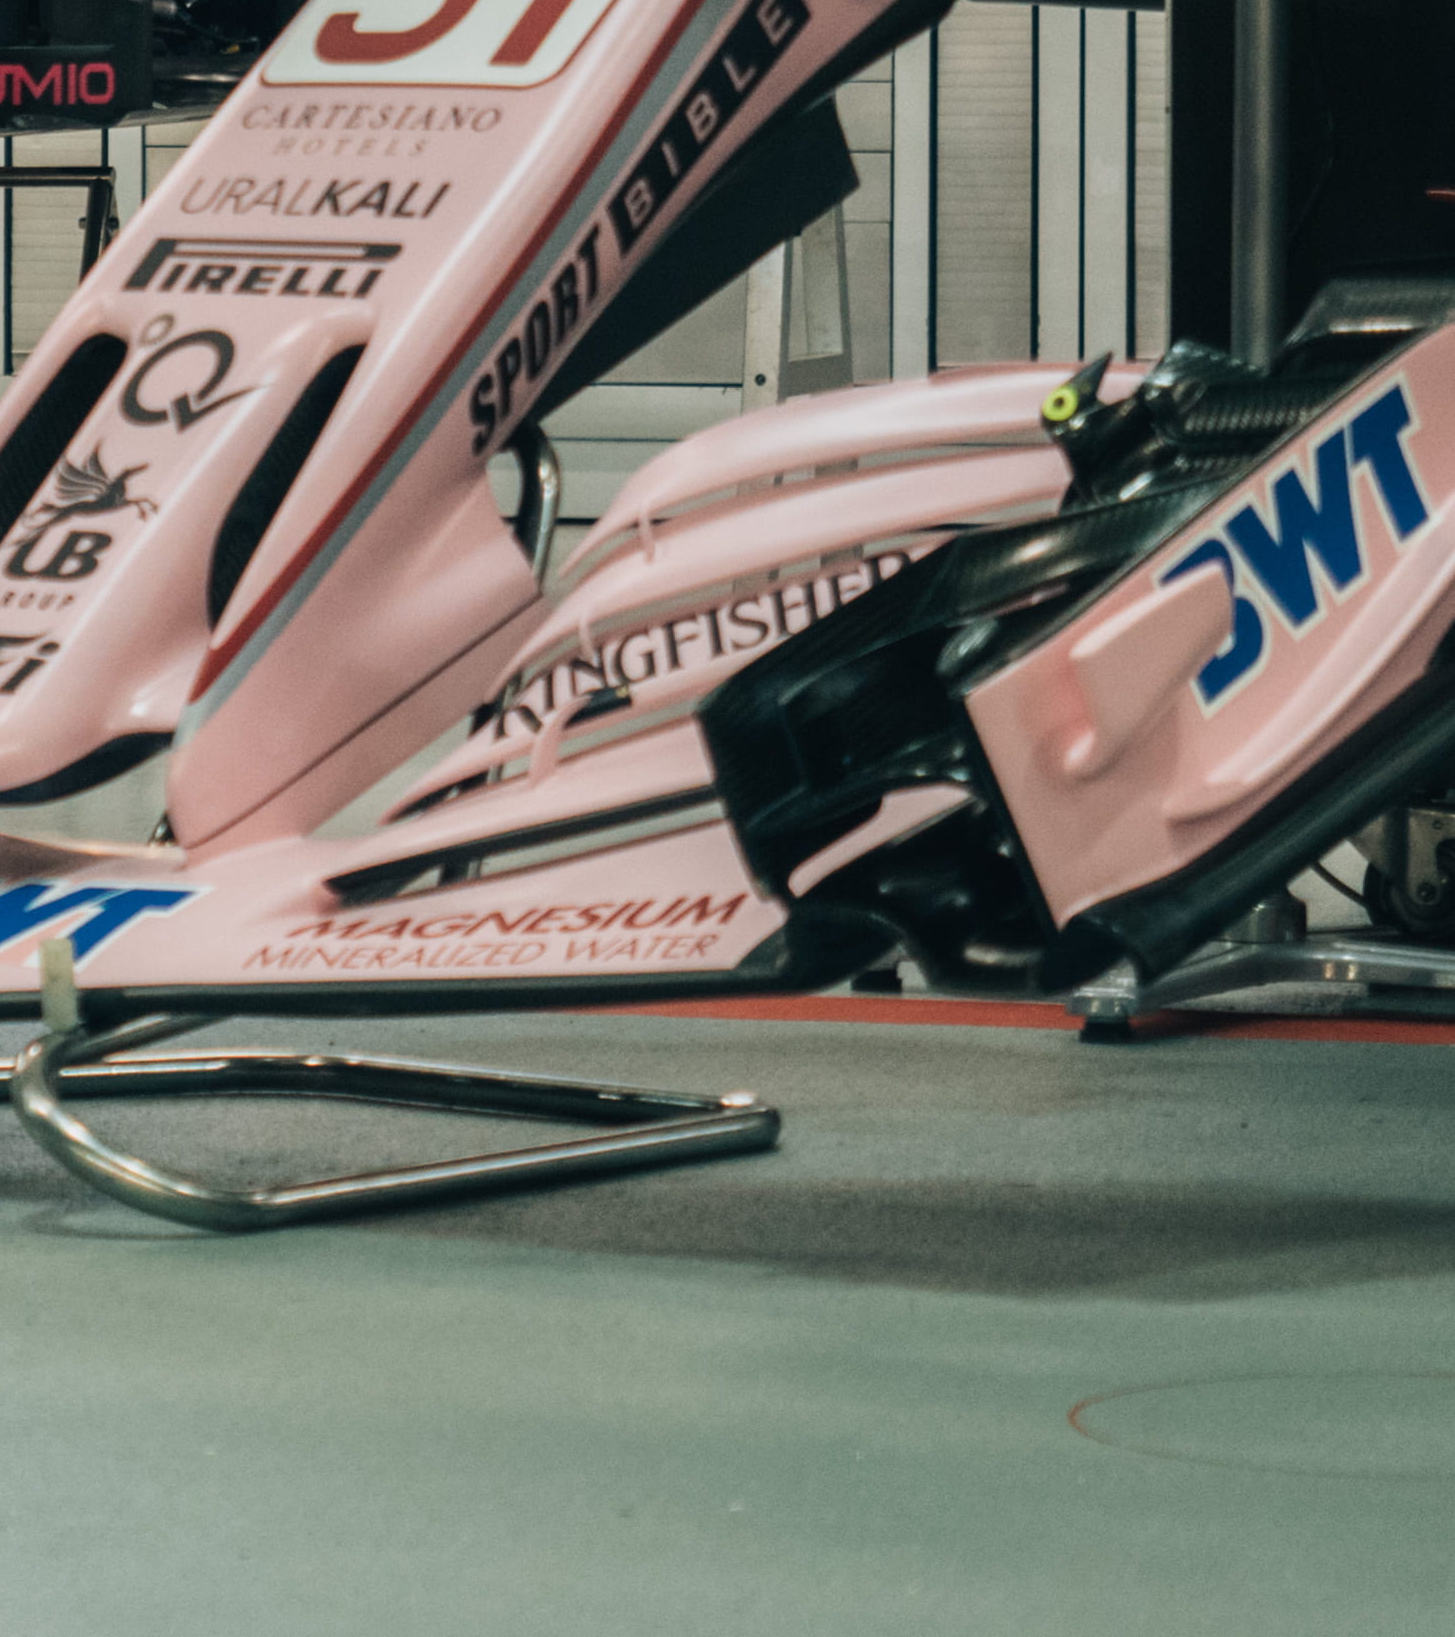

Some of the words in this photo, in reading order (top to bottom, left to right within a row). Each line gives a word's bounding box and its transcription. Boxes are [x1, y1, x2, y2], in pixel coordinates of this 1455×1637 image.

[241, 104, 503, 133] CARTESIANO
[180, 177, 452, 219] URALKALI
[121, 238, 403, 299] PIRELLI
[471, 226, 602, 457] SPORT
[288, 892, 749, 940] MAGNESIUM
[562, 933, 721, 963] WATER
